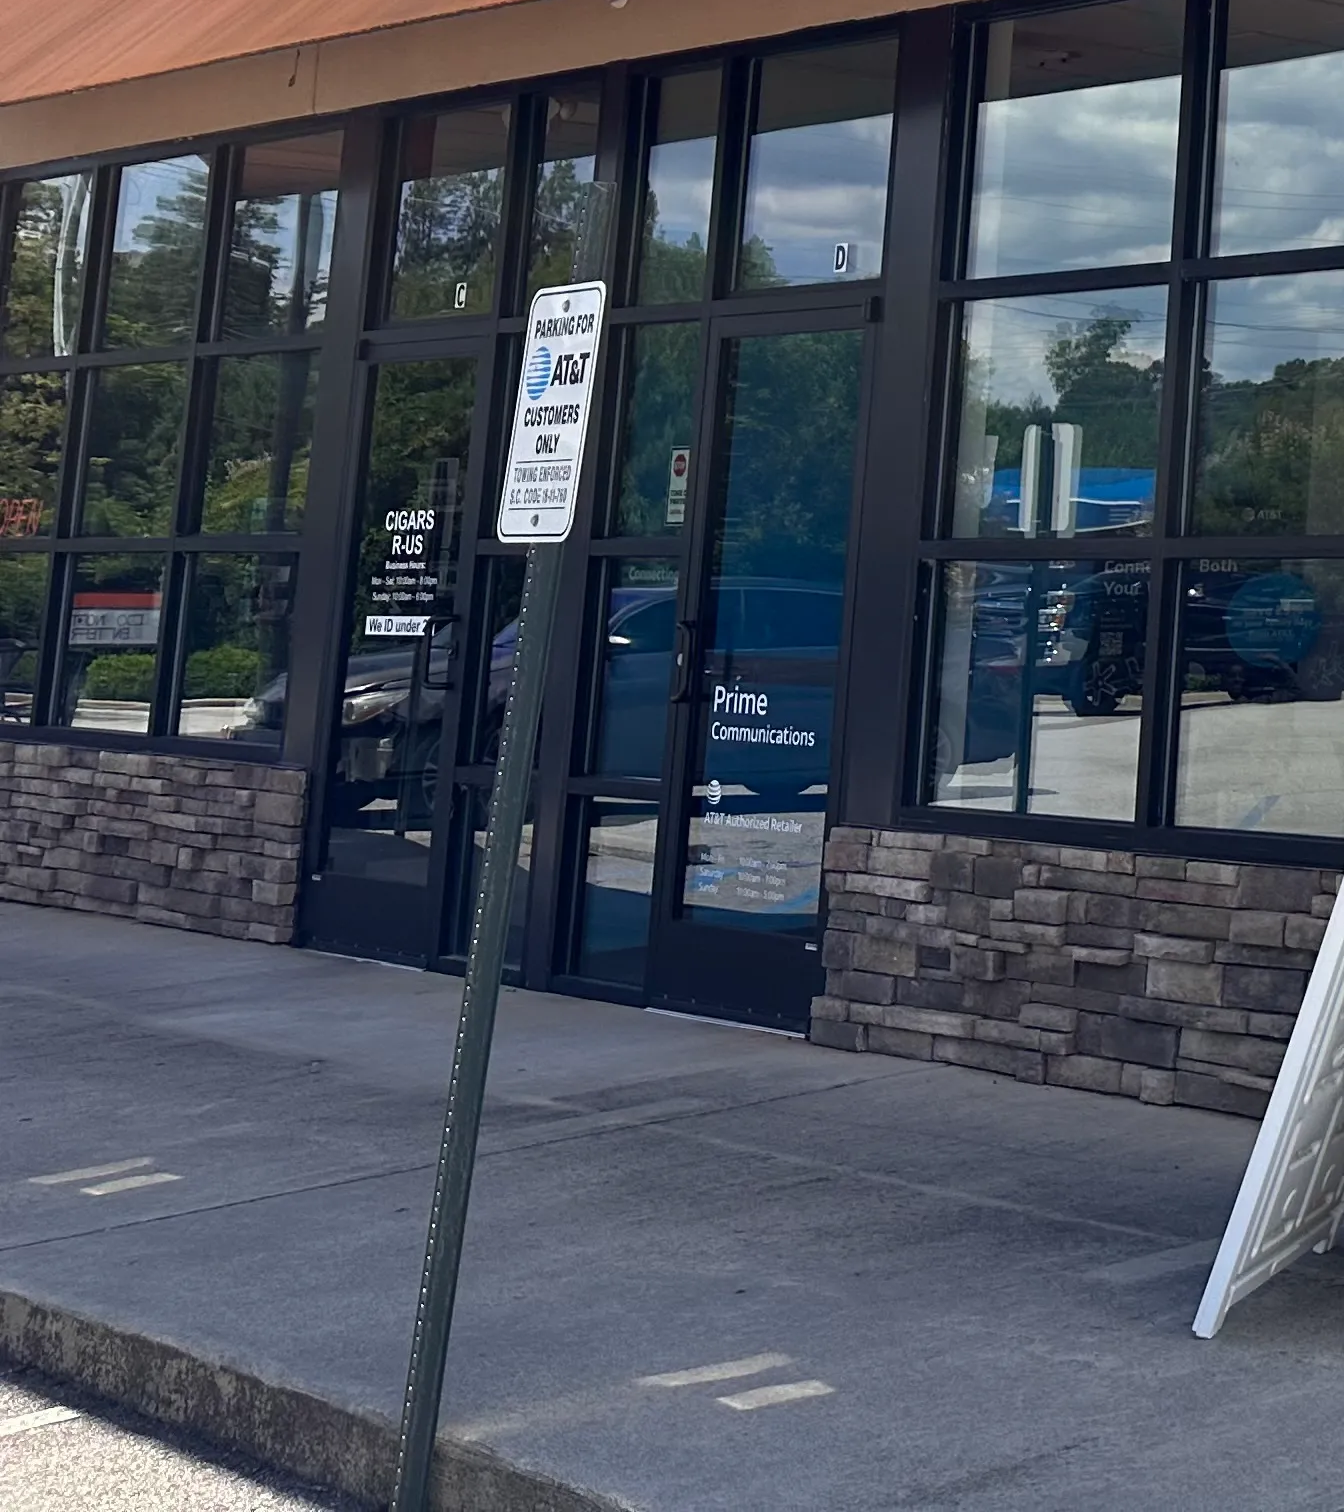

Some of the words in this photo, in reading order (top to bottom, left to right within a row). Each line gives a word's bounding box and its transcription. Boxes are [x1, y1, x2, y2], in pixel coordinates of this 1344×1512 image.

[835, 244, 848, 270] D
[456, 284, 466, 307] C
[534, 316, 576, 339] PARKING
[575, 313, 595, 335] FOR
[550, 352, 591, 386] AT&T
[524, 403, 581, 427] CUSTOMERS
[535, 432, 561, 456] ONLY
[513, 466, 538, 483] TOWING
[538, 464, 572, 483] ENFORCED
[523, 487, 542, 504] CODE
[385, 509, 436, 531] CIGARS
[1257, 509, 1283, 520] AT&T
[391, 534, 424, 555] R-US
[1200, 559, 1238, 573] Both
[369, 618, 383, 632] We
[384, 618, 394, 632] ID
[395, 618, 421, 633] under
[713, 685, 769, 716] Prime
[711, 721, 816, 748] Communications
[704, 811, 726, 826] AT&T
[725, 814, 770, 831] Authorized
[770, 818, 803, 834] Retailer
